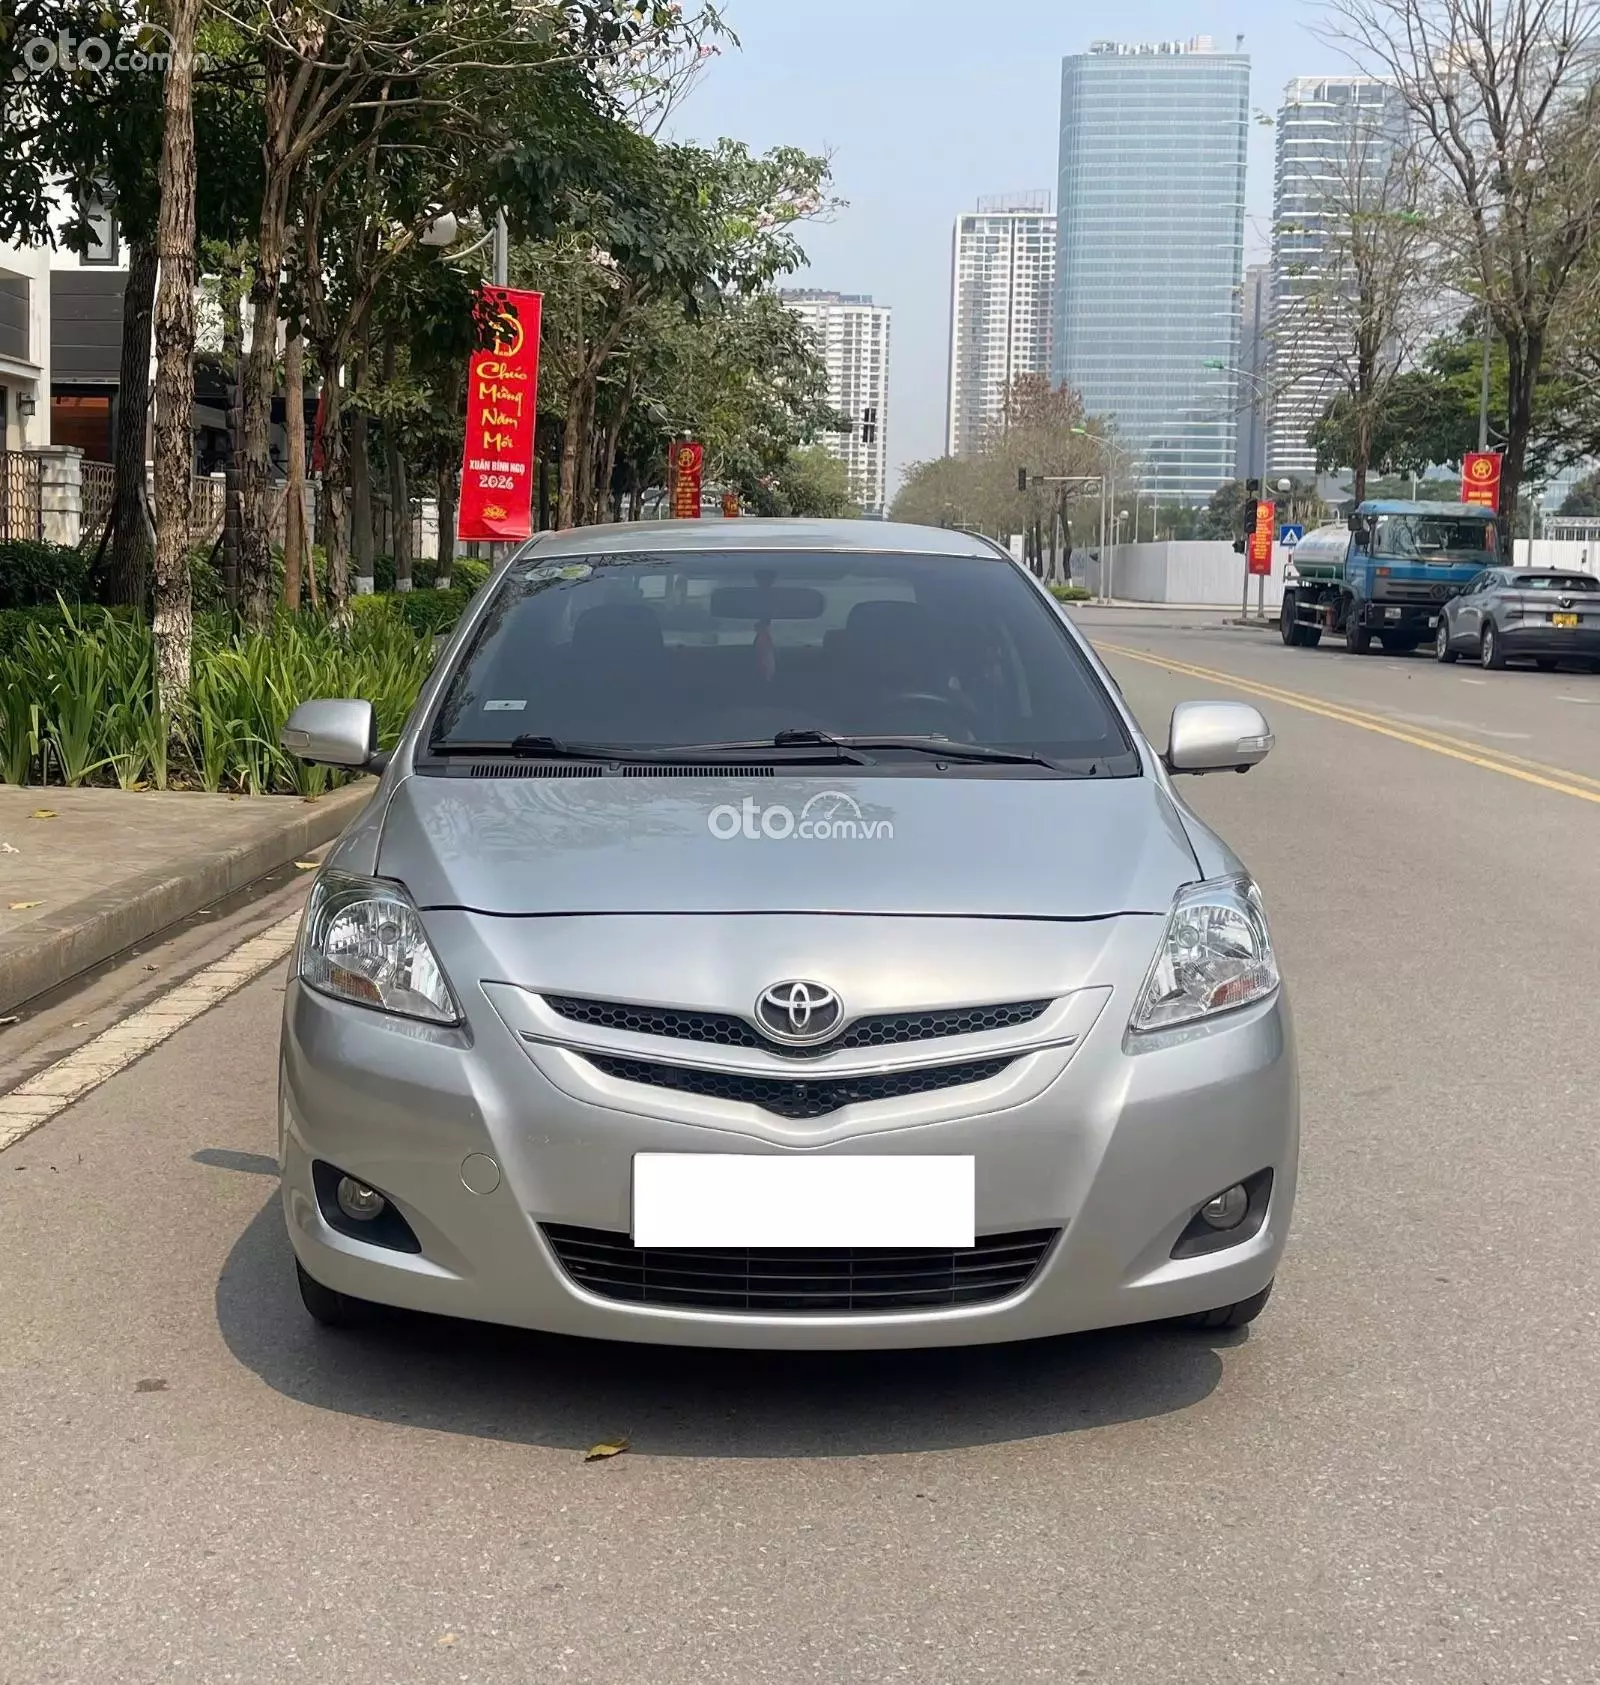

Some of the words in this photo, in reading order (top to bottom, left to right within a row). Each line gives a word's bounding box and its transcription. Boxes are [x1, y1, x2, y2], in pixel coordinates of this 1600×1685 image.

[476, 361, 527, 380] Chúc
[481, 407, 518, 430] Năm
[483, 431, 513, 452] Mới
[469, 458, 490, 471] XUÂN
[491, 460, 509, 472] BÍNH
[510, 462, 525, 476] NGỌ
[479, 474, 514, 490] 2026
